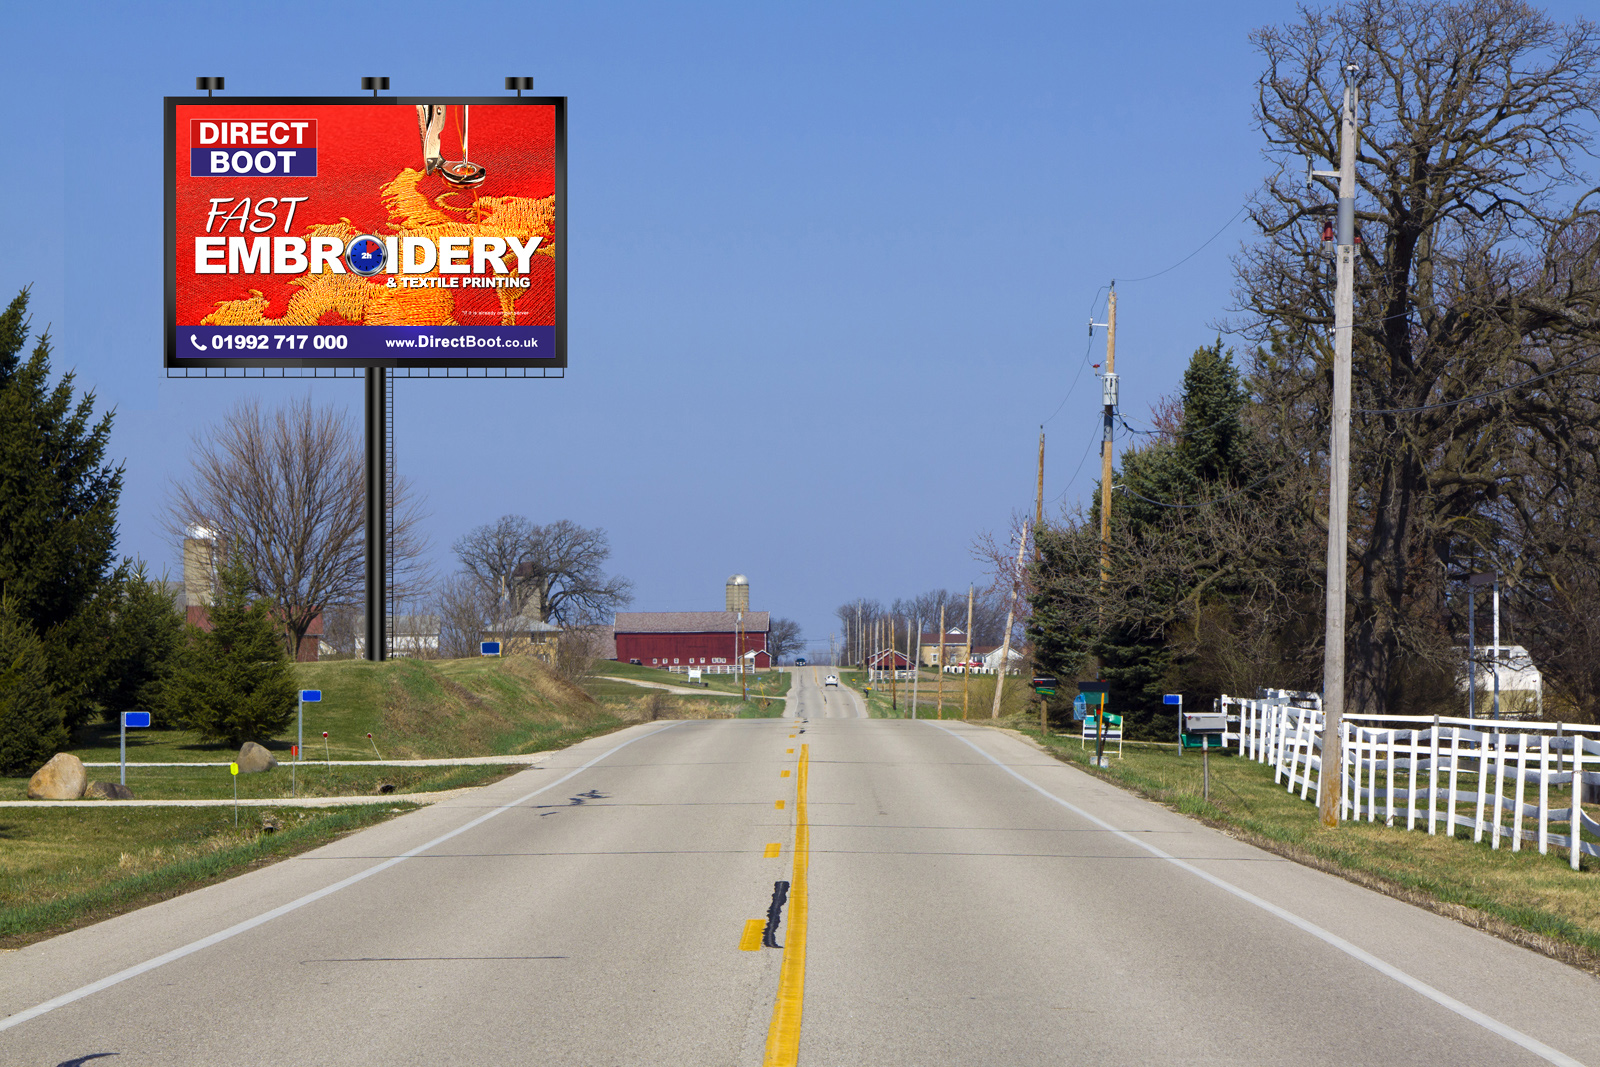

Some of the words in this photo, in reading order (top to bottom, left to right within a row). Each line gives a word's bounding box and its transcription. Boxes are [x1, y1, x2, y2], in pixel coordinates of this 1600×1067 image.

[199, 121, 309, 145] DIRECT
[210, 150, 297, 174] BOOT
[205, 196, 310, 234] FAST
[361, 252, 372, 260] 2h
[386, 277, 398, 288] &
[402, 277, 459, 288] TEXTILE
[462, 277, 531, 288] PRINTING
[211, 334, 270, 350] 01992
[273, 334, 309, 350] 717
[312, 334, 349, 350] 000
[385, 334, 539, 348] www.DirectBoot.co.uk
